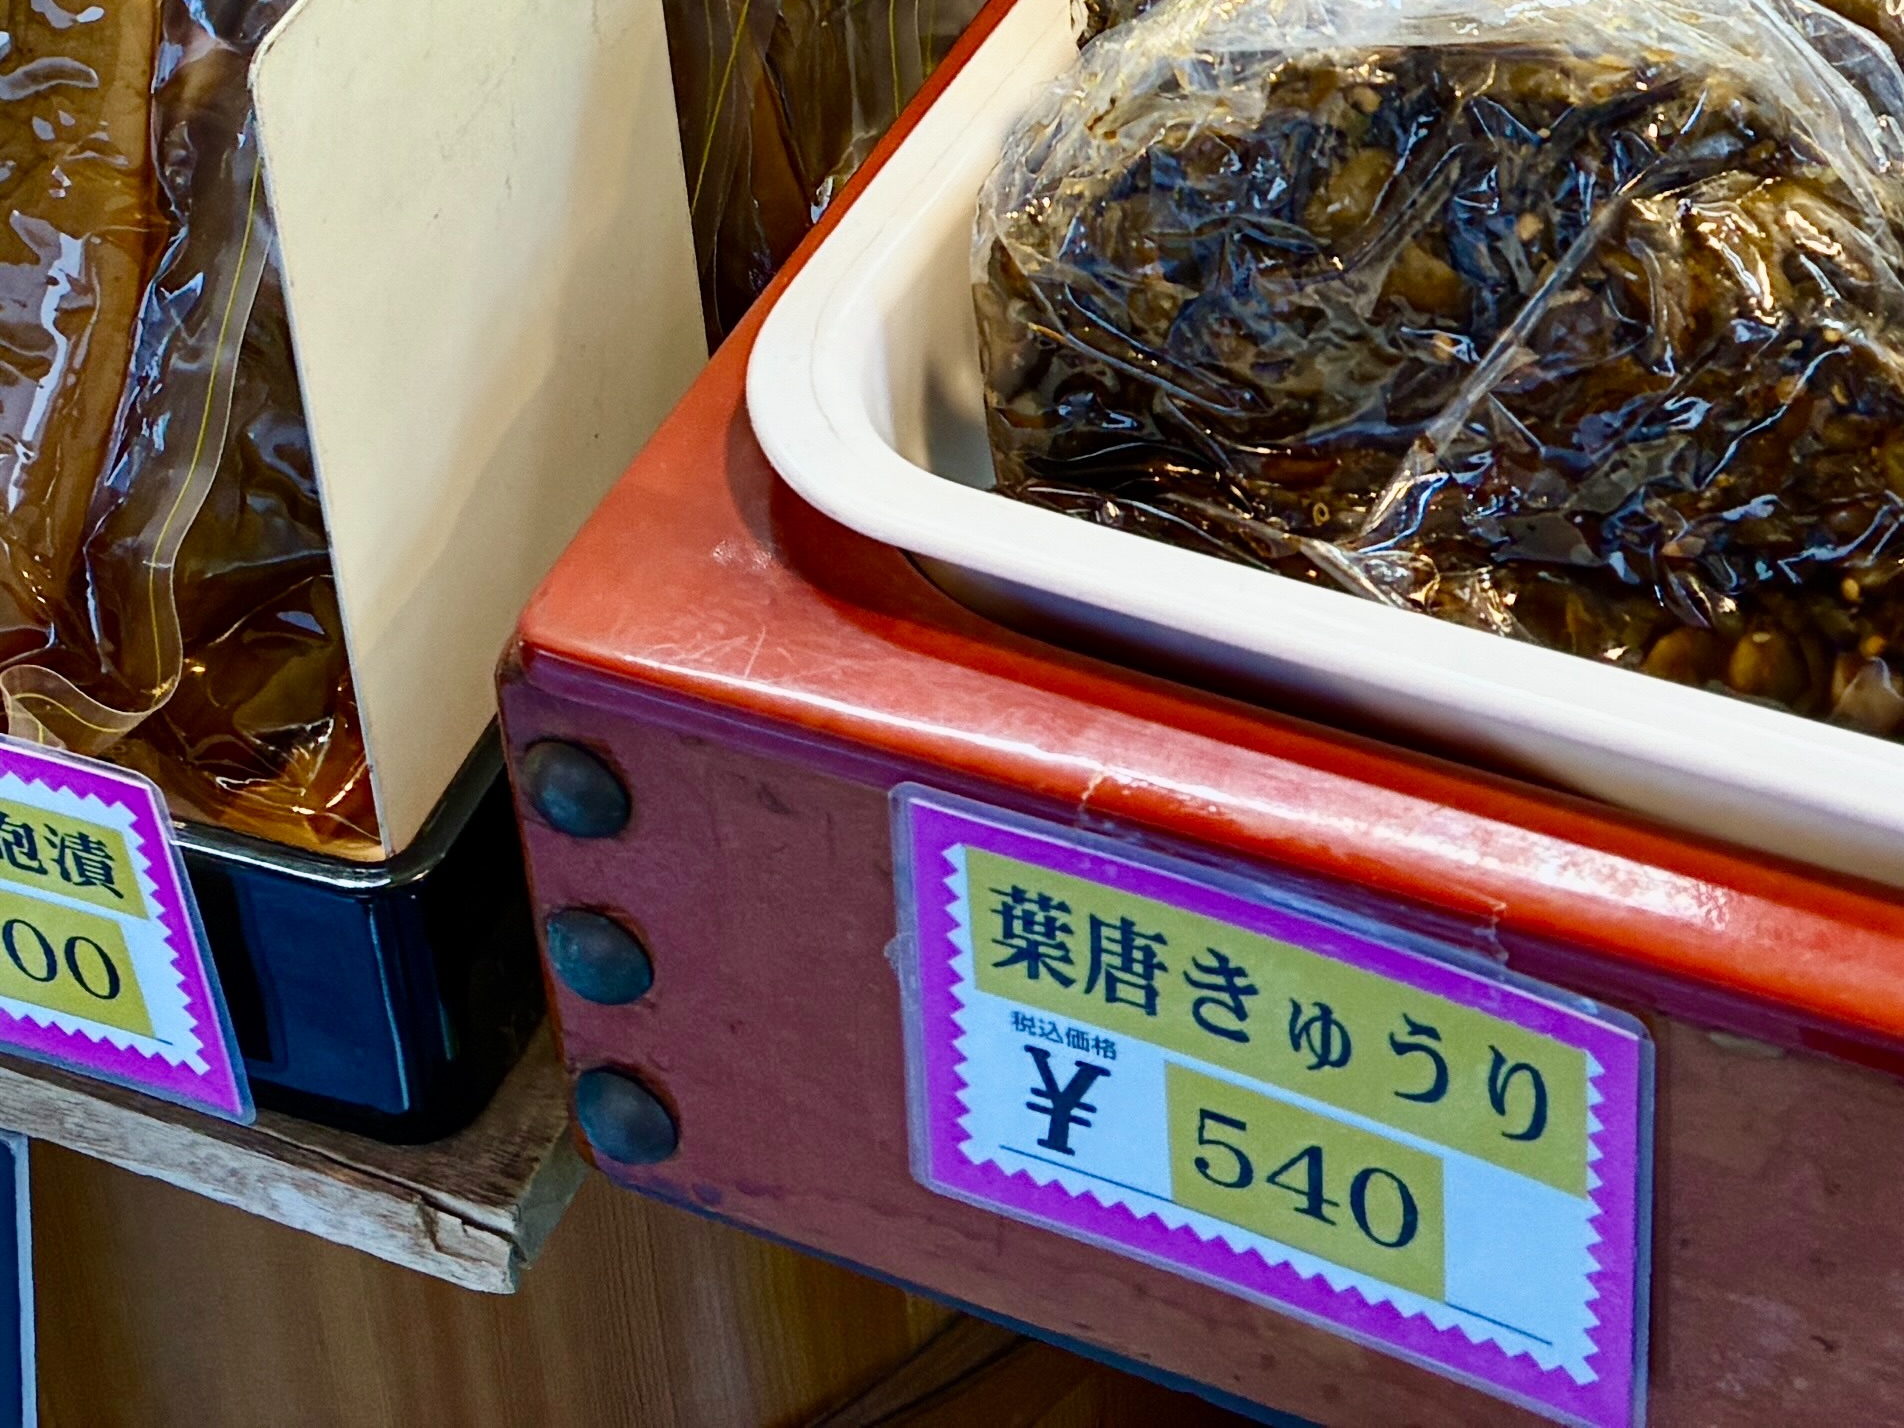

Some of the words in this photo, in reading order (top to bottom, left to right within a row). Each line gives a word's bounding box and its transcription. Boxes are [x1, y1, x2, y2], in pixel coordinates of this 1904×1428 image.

[989, 884, 1550, 1143] 葉唐きゅうり
[1011, 1008, 1119, 1062] 税込価格
[1024, 1044, 1111, 1157] ¥
[1193, 1108, 1420, 1251] 540
